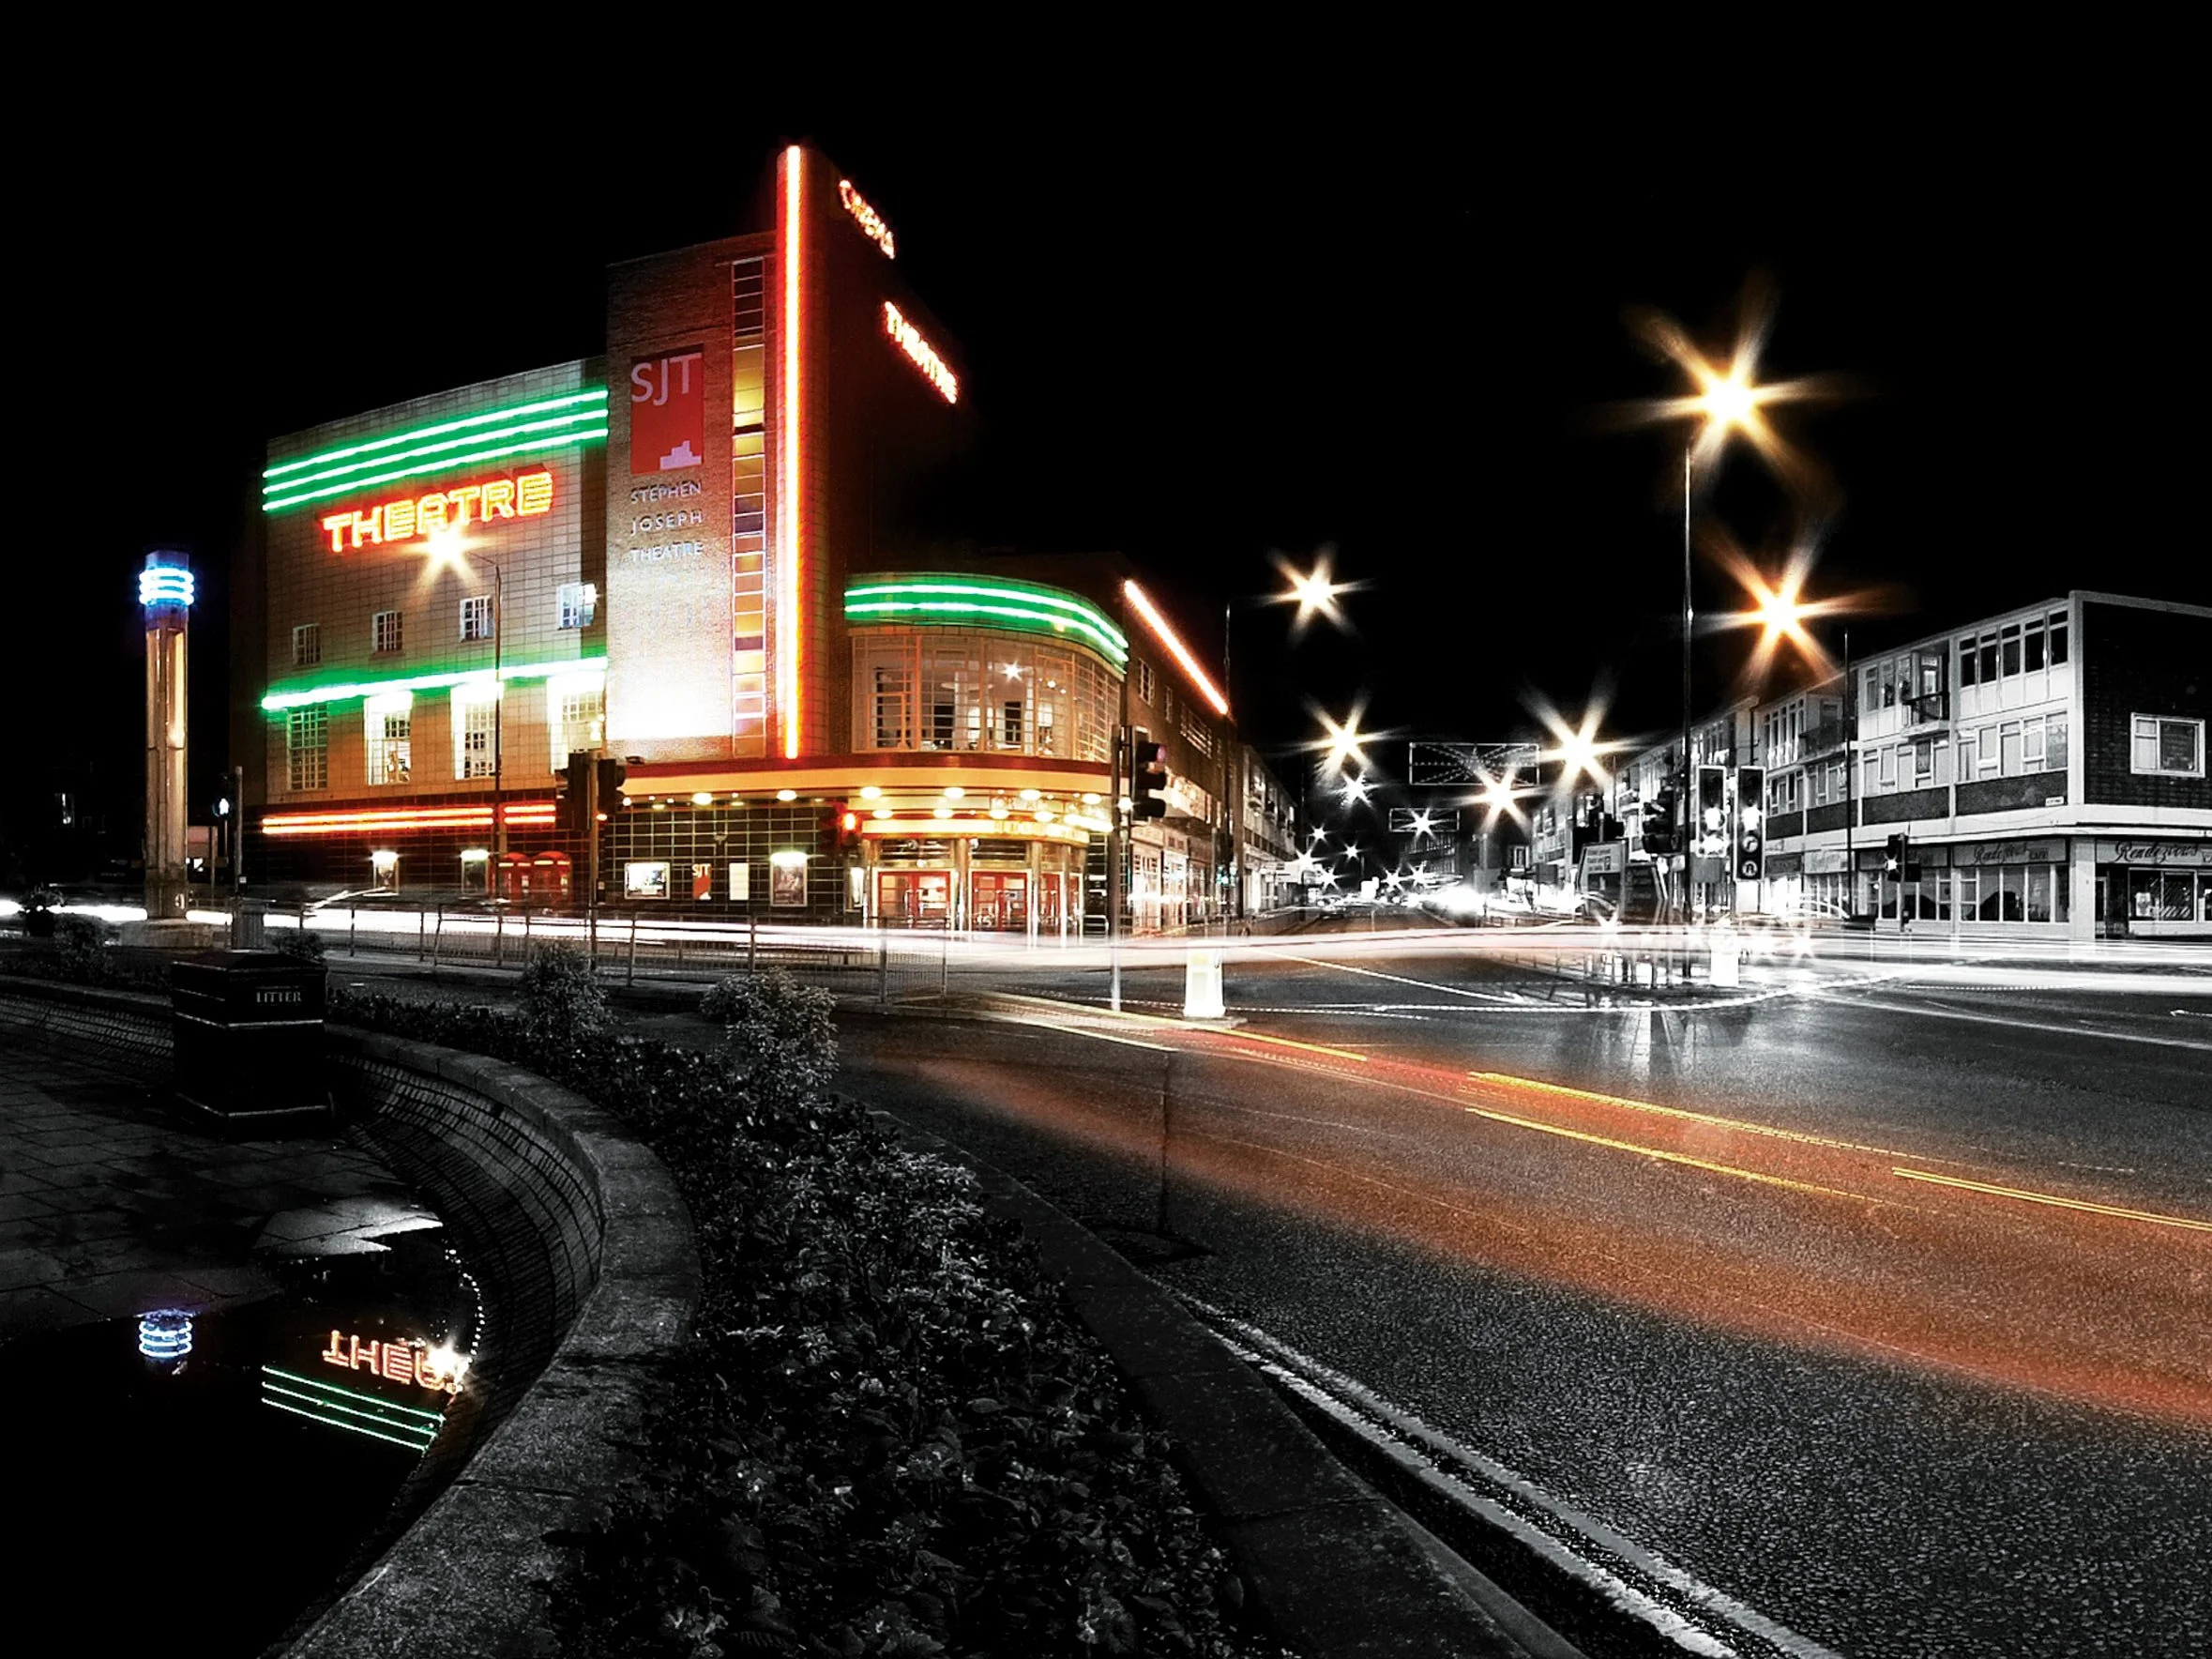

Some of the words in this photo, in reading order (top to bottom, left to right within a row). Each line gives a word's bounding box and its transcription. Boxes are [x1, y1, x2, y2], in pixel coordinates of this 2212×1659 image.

[630, 352, 703, 406] SJT
[629, 480, 702, 505] STEPHEN
[322, 471, 554, 553] THEATRE
[629, 510, 703, 536] JOSEPH
[629, 540, 704, 563] THEATRE
[691, 863, 712, 878] SJT
[256, 991, 301, 1003] LITTER
